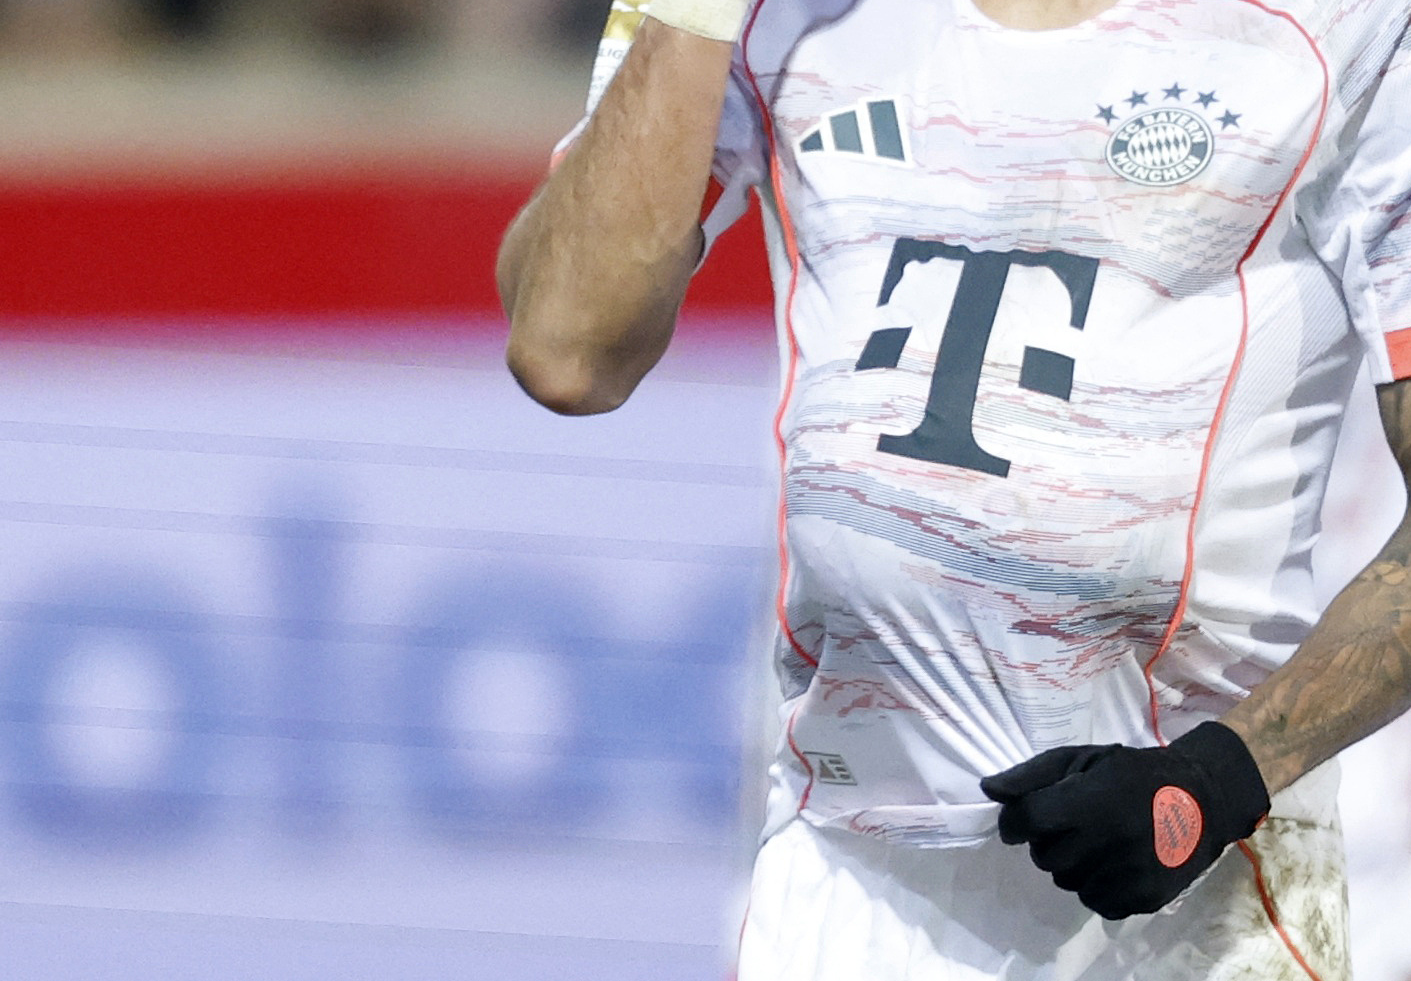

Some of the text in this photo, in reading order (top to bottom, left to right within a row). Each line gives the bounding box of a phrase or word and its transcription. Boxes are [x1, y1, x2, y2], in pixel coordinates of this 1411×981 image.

[1117, 111, 1206, 143] FC BAYERN
[854, 236, 1100, 478] T
